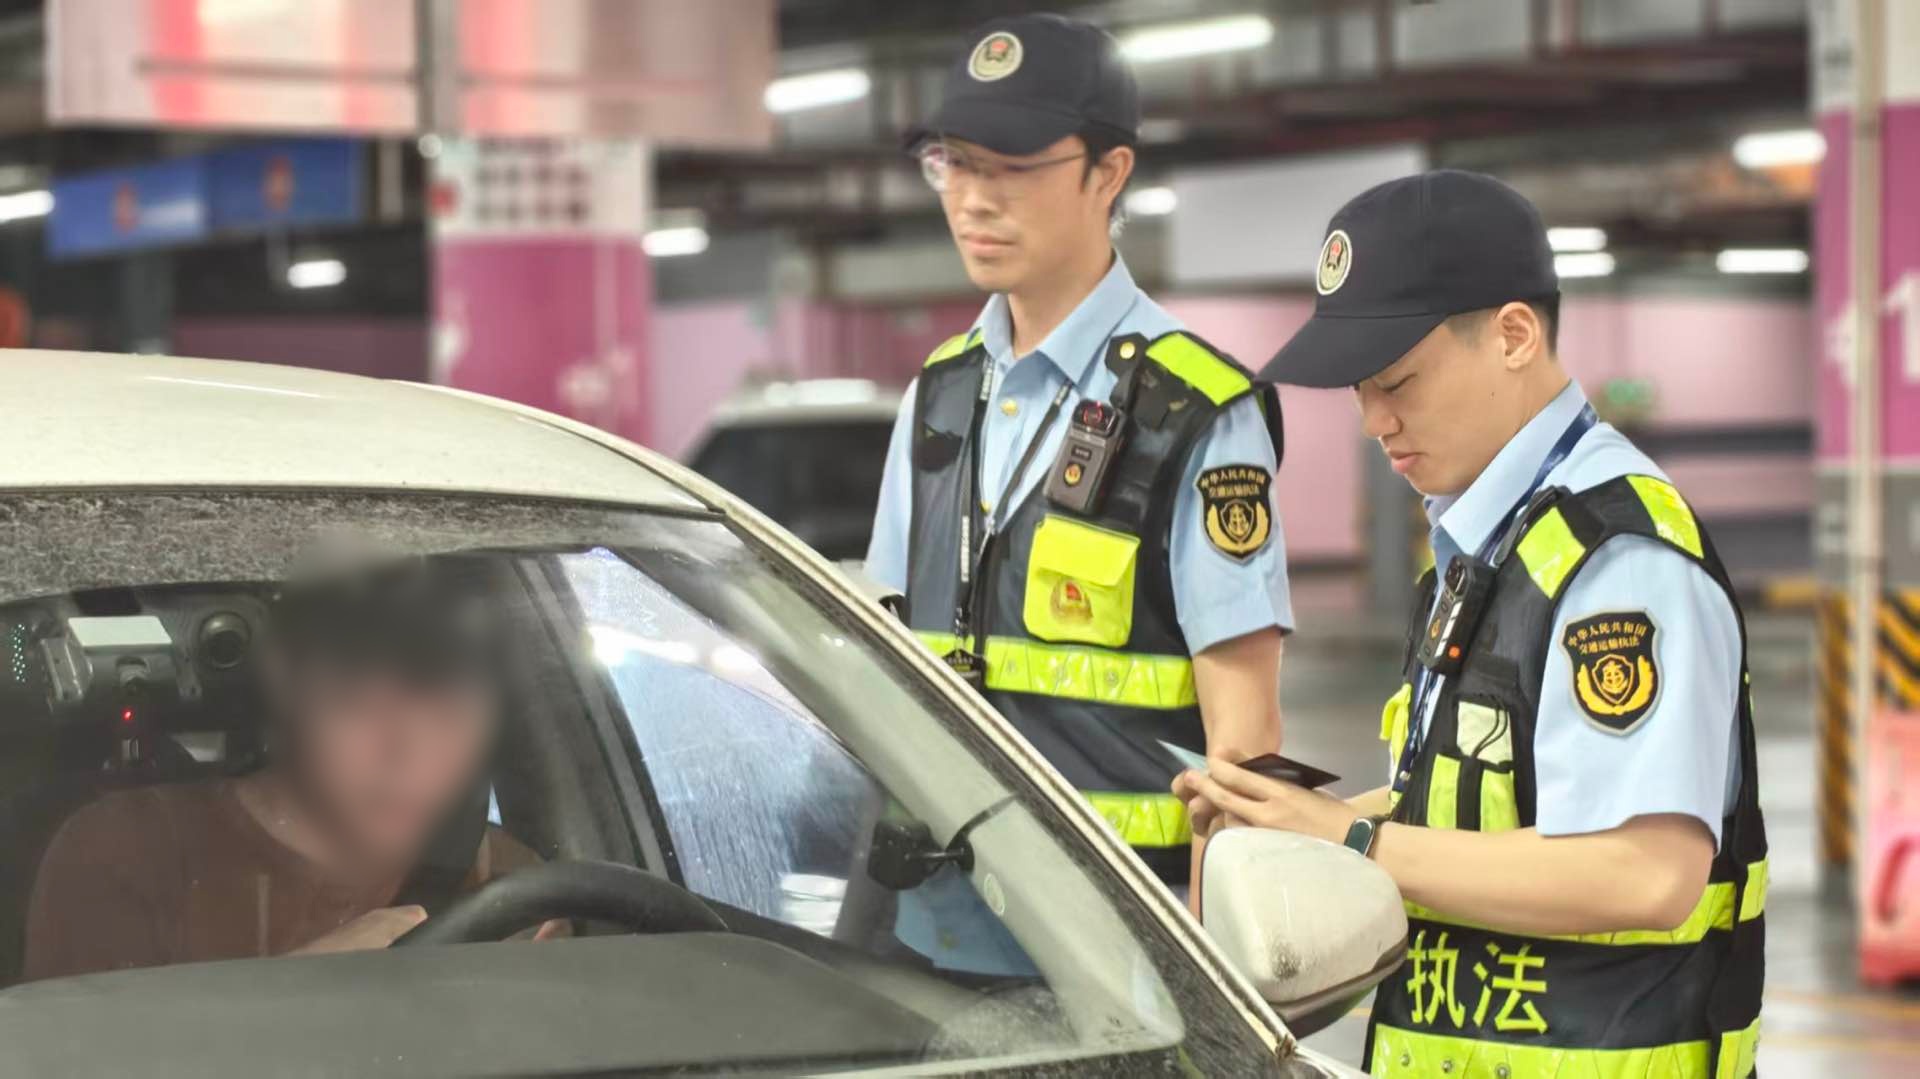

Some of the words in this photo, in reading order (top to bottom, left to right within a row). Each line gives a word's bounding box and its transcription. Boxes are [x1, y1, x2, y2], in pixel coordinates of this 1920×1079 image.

[1568, 621, 1647, 646] 中华人民共和国
[1579, 636, 1640, 654] 交通运输执法
[1406, 929, 1548, 1035] 执法
